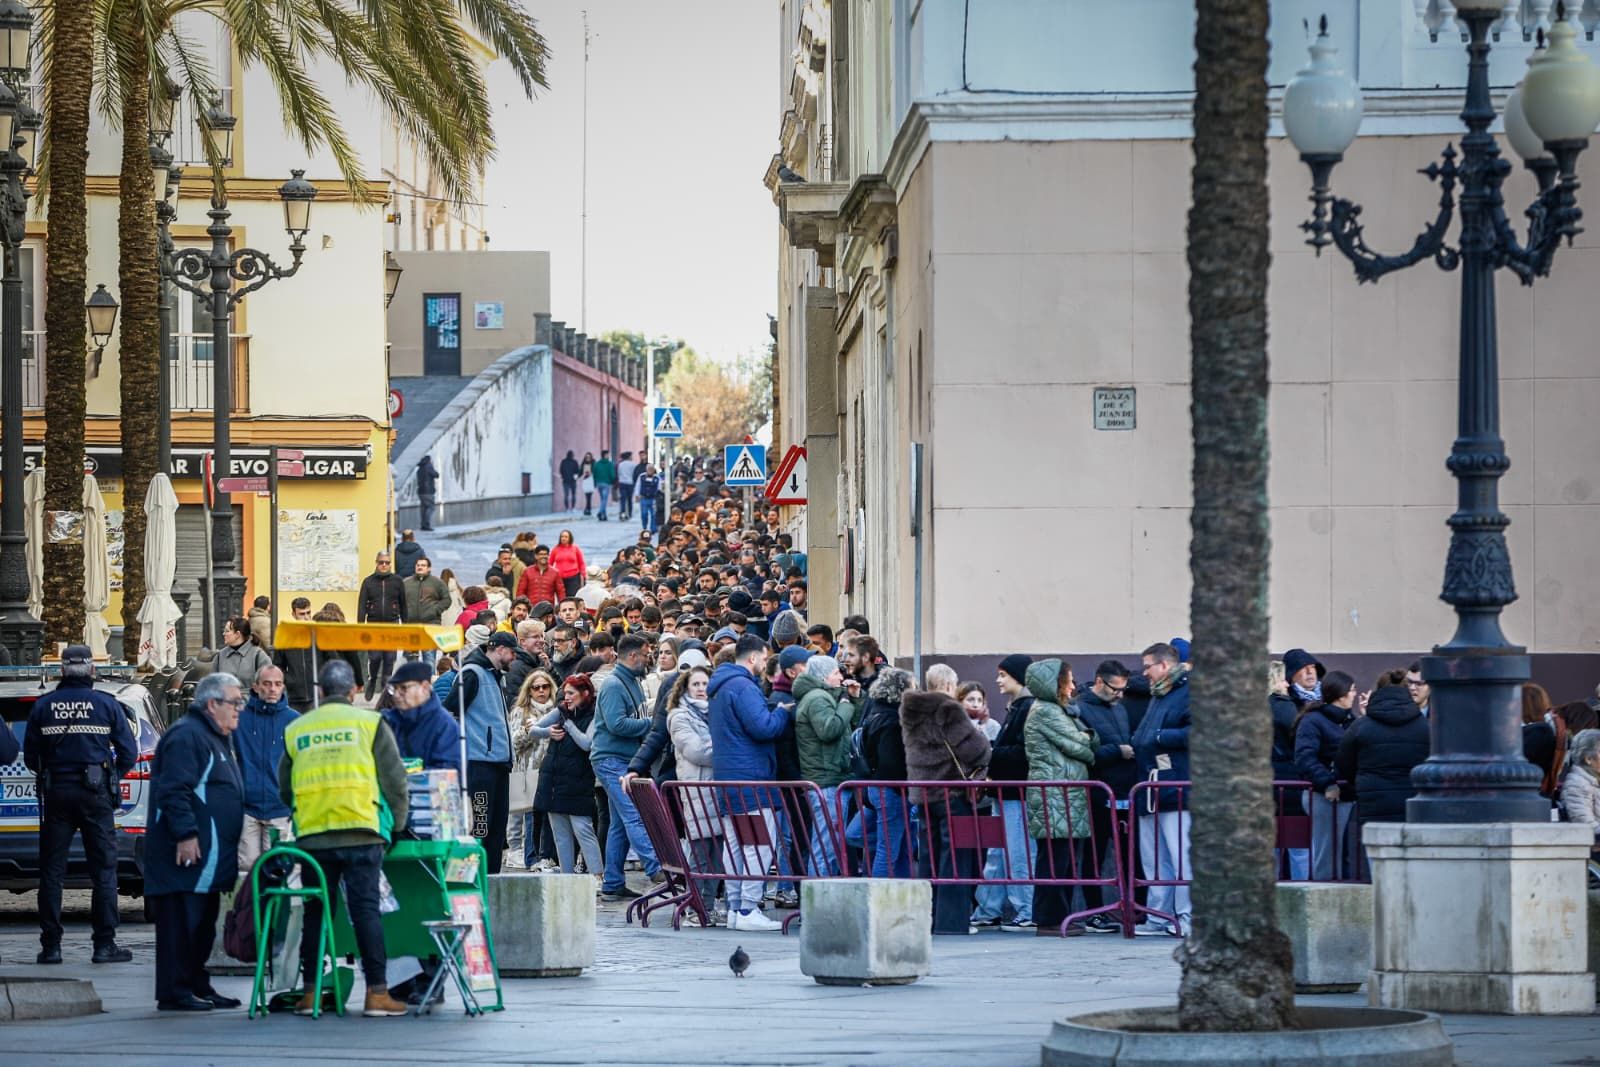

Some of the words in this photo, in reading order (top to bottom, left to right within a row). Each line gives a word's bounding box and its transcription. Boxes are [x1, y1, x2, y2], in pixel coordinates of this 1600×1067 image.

[1098, 410, 1121, 418] JUAN
[50, 702, 94, 711] POLICIA
[55, 711, 90, 719] LOCAL
[312, 731, 353, 744] ONCE
